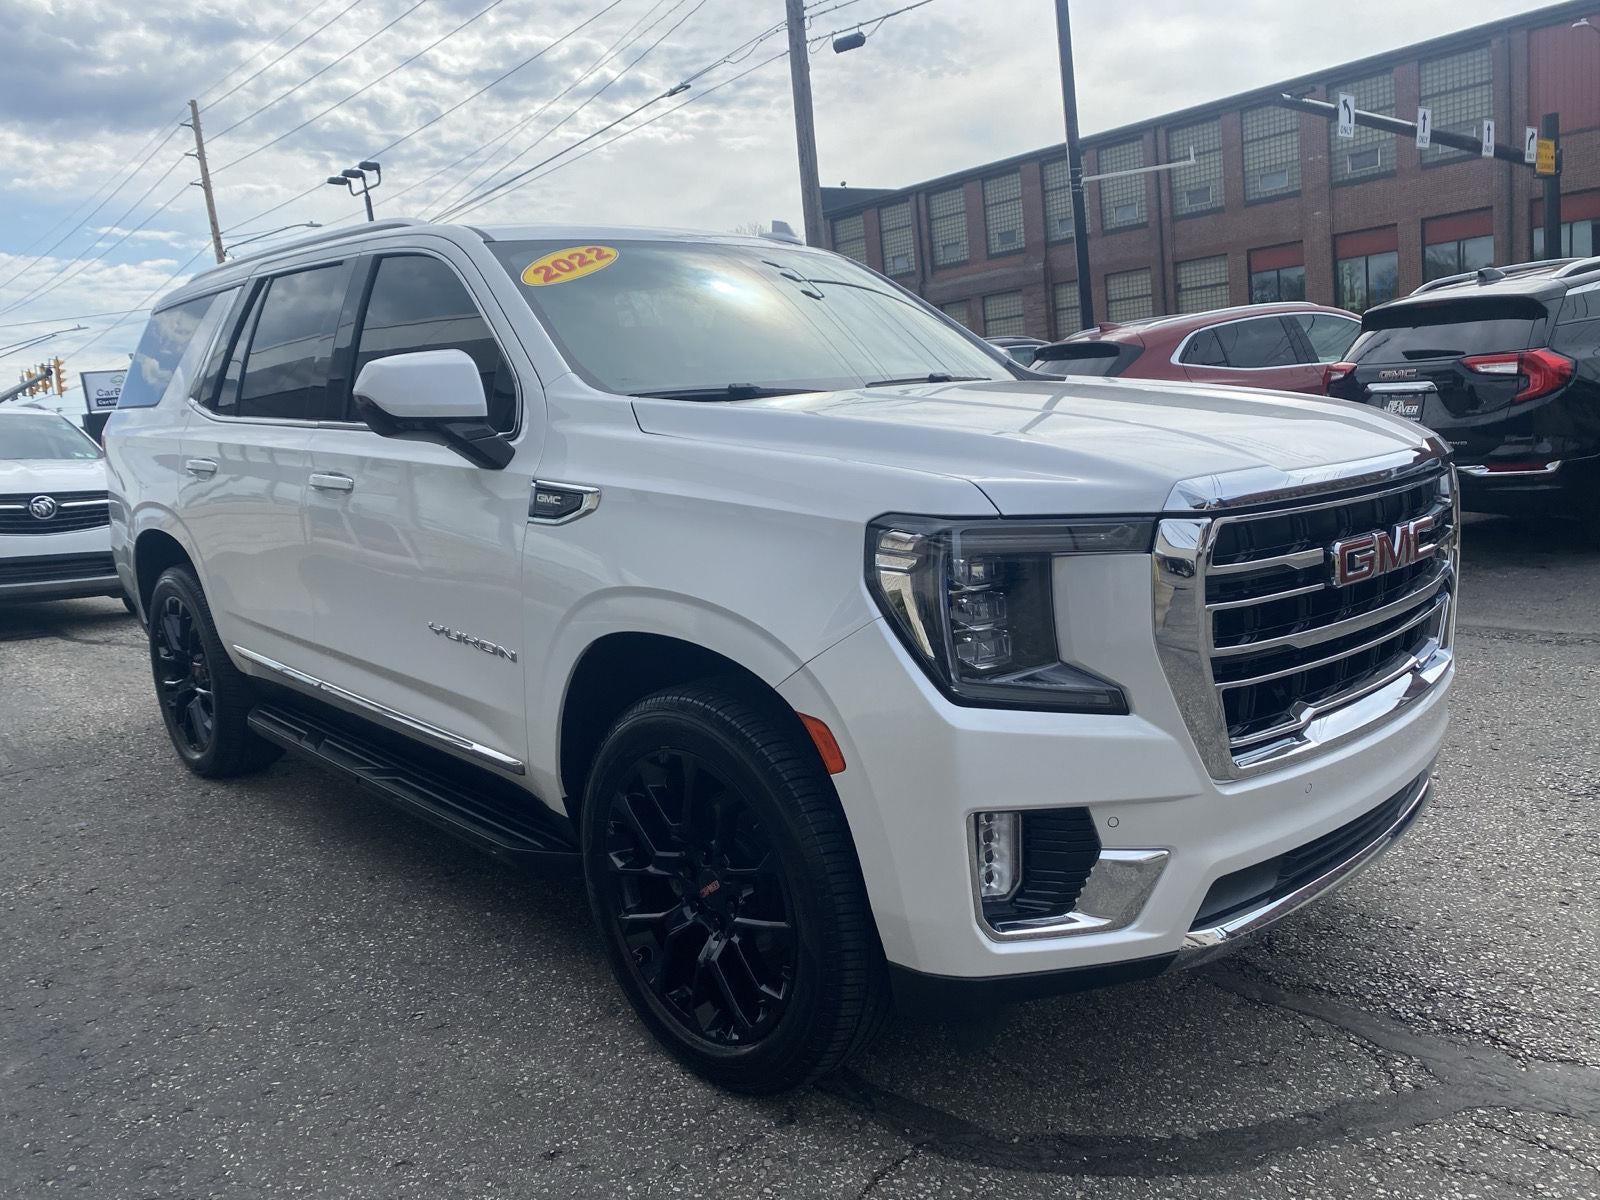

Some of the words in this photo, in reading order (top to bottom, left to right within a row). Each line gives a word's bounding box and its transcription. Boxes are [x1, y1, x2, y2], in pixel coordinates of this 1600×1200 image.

[533, 247, 613, 283] 2022
[1379, 369, 1417, 379] GMC
[537, 493, 561, 505] GMC
[1334, 515, 1438, 588] GMC
[428, 621, 518, 663] YUKON
